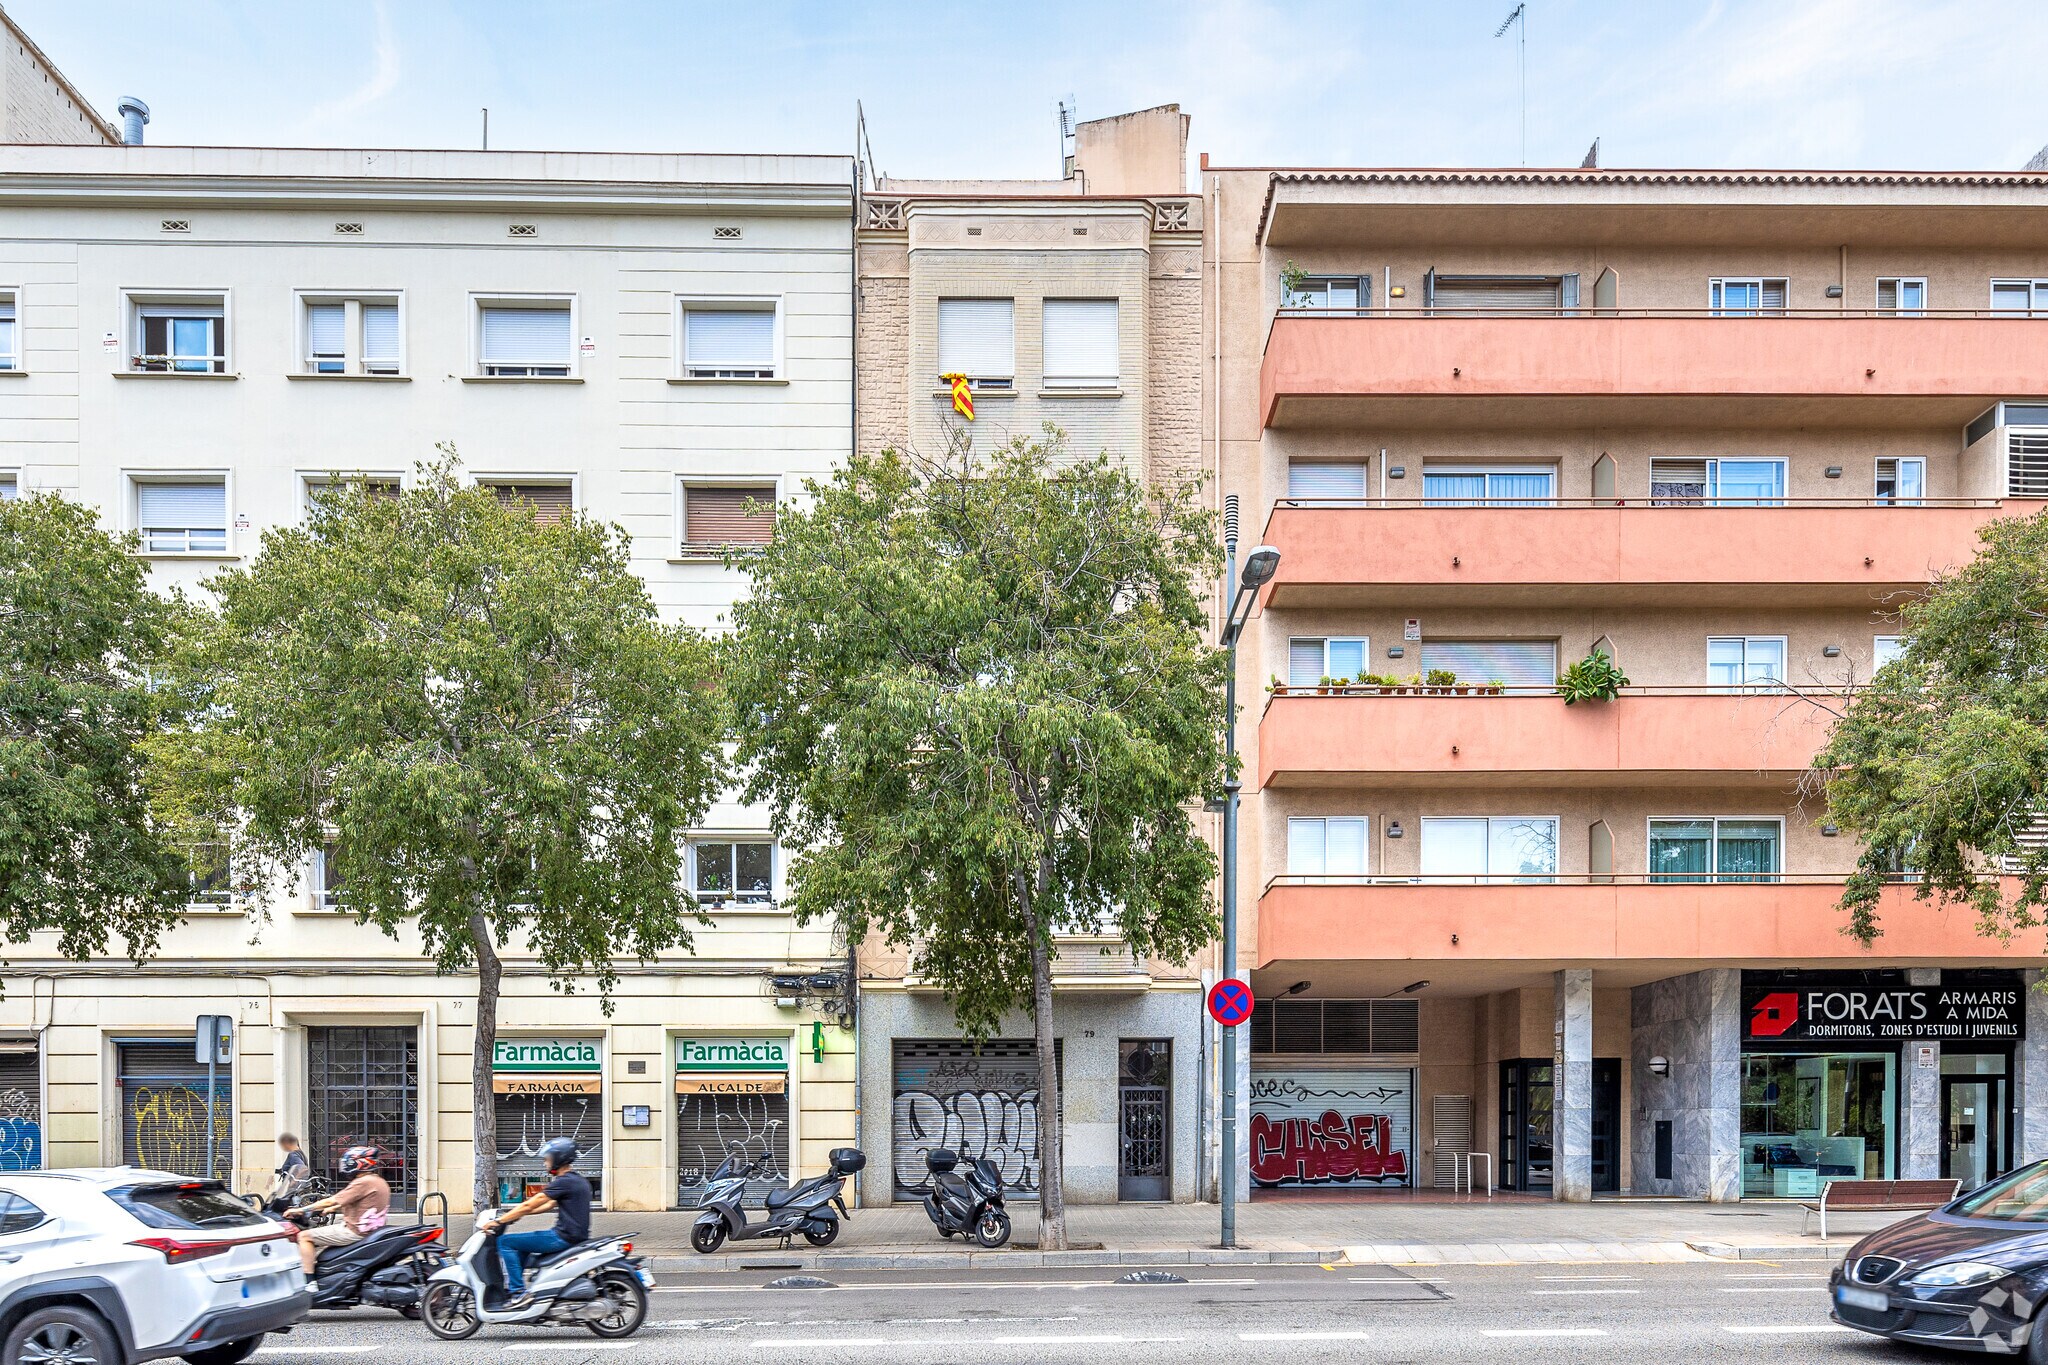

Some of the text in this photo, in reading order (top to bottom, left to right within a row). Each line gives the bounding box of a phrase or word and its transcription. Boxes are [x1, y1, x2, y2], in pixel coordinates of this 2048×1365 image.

[1939, 991, 2017, 1005] ARMARIS
[1807, 992, 1927, 1020] FORATS
[1946, 1006, 2009, 1020] A MIDA
[1084, 1030, 1095, 1038] 79
[1809, 1024, 1875, 1037] DORMITORIS,
[1880, 1024, 1913, 1036] ZONES
[1965, 1024, 1969, 1036] I
[1971, 1024, 2018, 1038] JUVENILS
[493, 1040, 596, 1062] Farmàcia
[682, 1040, 784, 1062] Farmàcia
[508, 1081, 585, 1092] FARMÀCIA
[697, 1083, 763, 1093] ALCALDE
